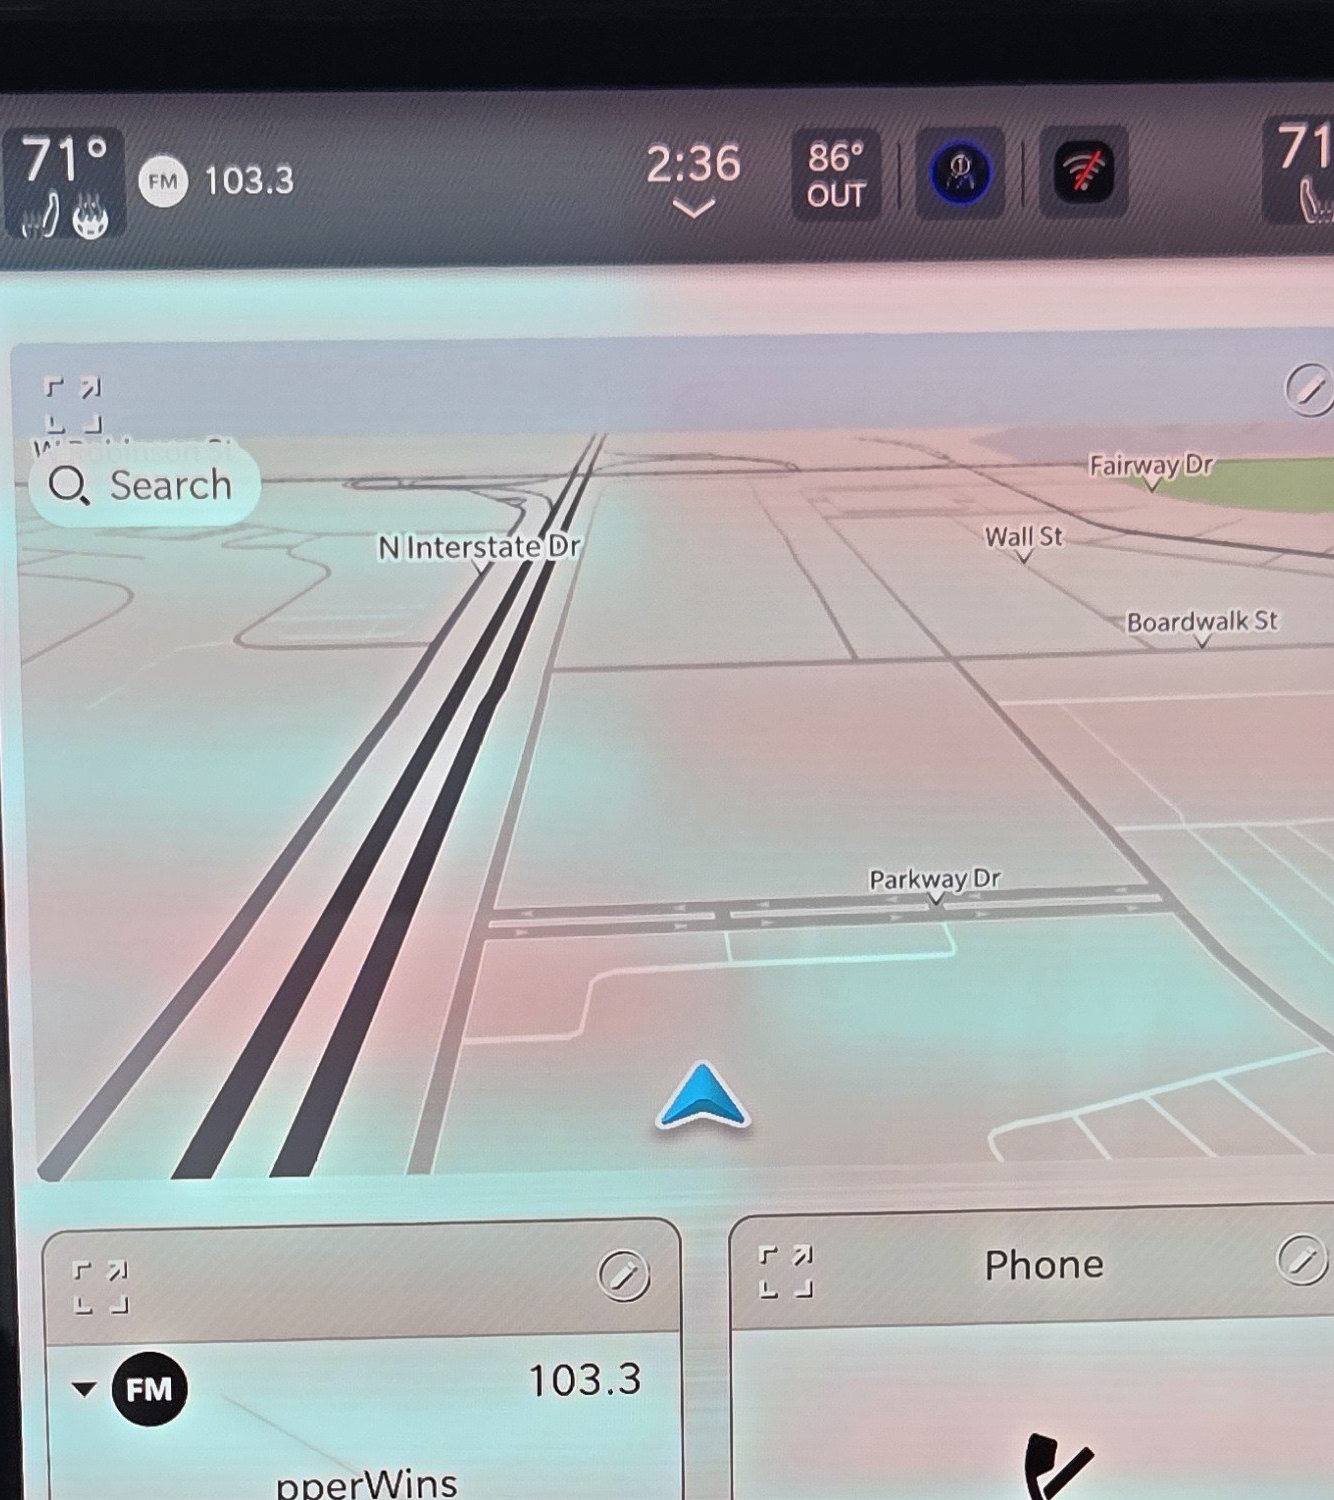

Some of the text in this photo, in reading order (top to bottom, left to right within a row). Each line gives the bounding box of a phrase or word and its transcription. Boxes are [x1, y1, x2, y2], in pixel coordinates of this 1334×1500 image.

[21, 135, 108, 183] 71°
[645, 143, 742, 184] 2:36
[808, 140, 865, 172] 86°
[148, 172, 178, 190] FM
[205, 164, 295, 196] 103.3
[806, 182, 867, 208] OUT
[1091, 452, 1216, 480] Fairway Dr
[110, 466, 232, 500] Search
[379, 533, 581, 560] N Interstate Dr
[986, 524, 1063, 549] Wall St
[1127, 609, 1278, 634] Boardwalk St
[870, 868, 1001, 892] Parkway Dr
[985, 1250, 1104, 1281] Phone
[126, 1375, 172, 1401] FM
[528, 1362, 642, 1397] 103.3
